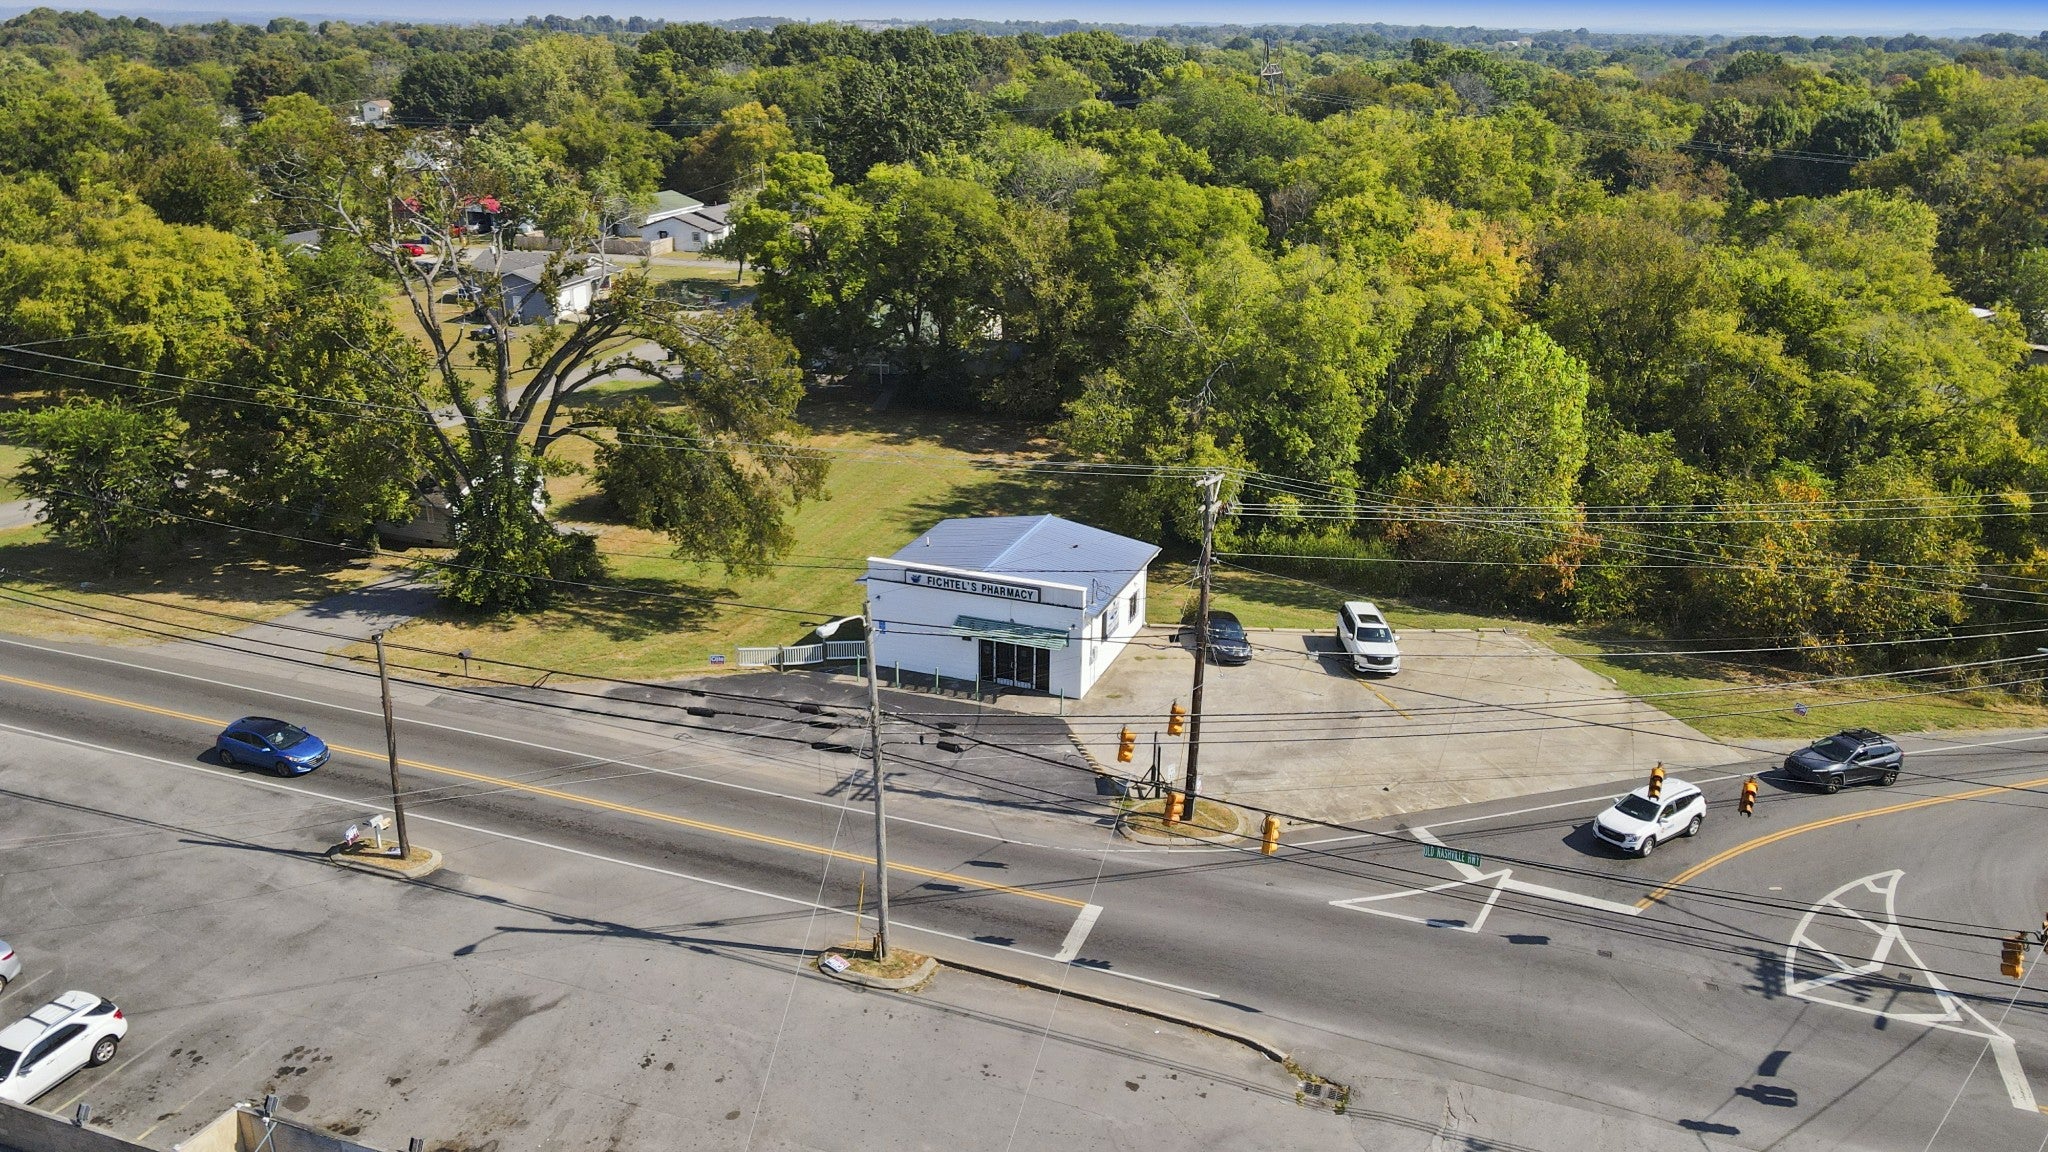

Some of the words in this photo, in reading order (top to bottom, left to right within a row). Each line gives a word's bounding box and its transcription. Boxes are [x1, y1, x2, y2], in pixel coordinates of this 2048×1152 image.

[927, 576, 977, 592] FICHTEL'S
[981, 584, 1034, 600] PHARMACY
[1423, 845, 1435, 857] OLD
[1436, 848, 1465, 862] NASHVILLE
[1467, 853, 1480, 866] HWY
